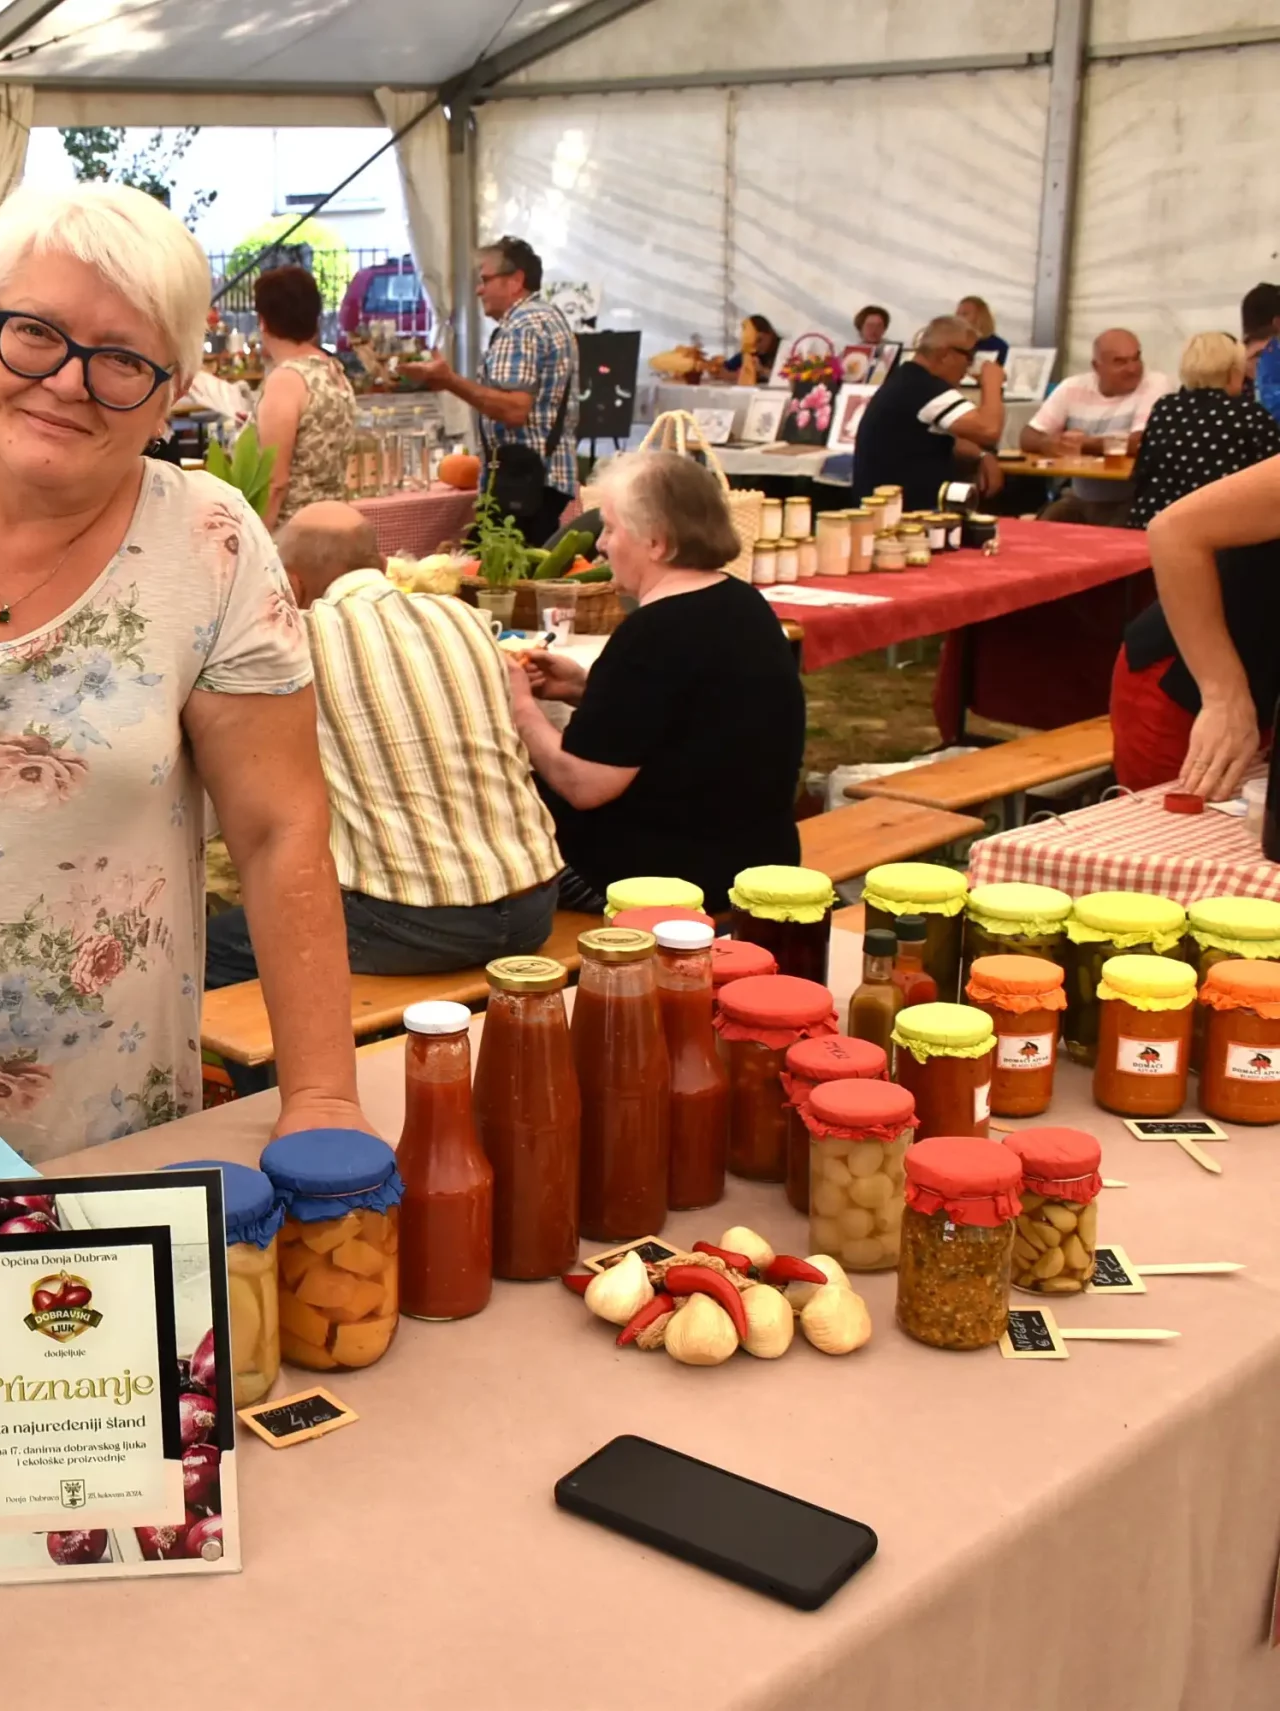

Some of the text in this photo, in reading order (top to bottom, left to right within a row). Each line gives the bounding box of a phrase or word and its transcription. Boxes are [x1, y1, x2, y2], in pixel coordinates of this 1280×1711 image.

[1, 1252, 118, 1268] Općina Donja Dubrava
[35, 1309, 91, 1324] DOBRAVSKI
[51, 1323, 76, 1333] LJUK
[44, 1348, 86, 1359] dodjeljuje
[23, 1445, 62, 1455] danima
[63, 1442, 121, 1454] dobravskog
[122, 1440, 147, 1451] ljuka
[22, 1455, 65, 1467] ekološke
[66, 1453, 126, 1466] proizvodnje
[5, 1496, 27, 1504] Donja
[29, 1495, 60, 1503] Dubrava
